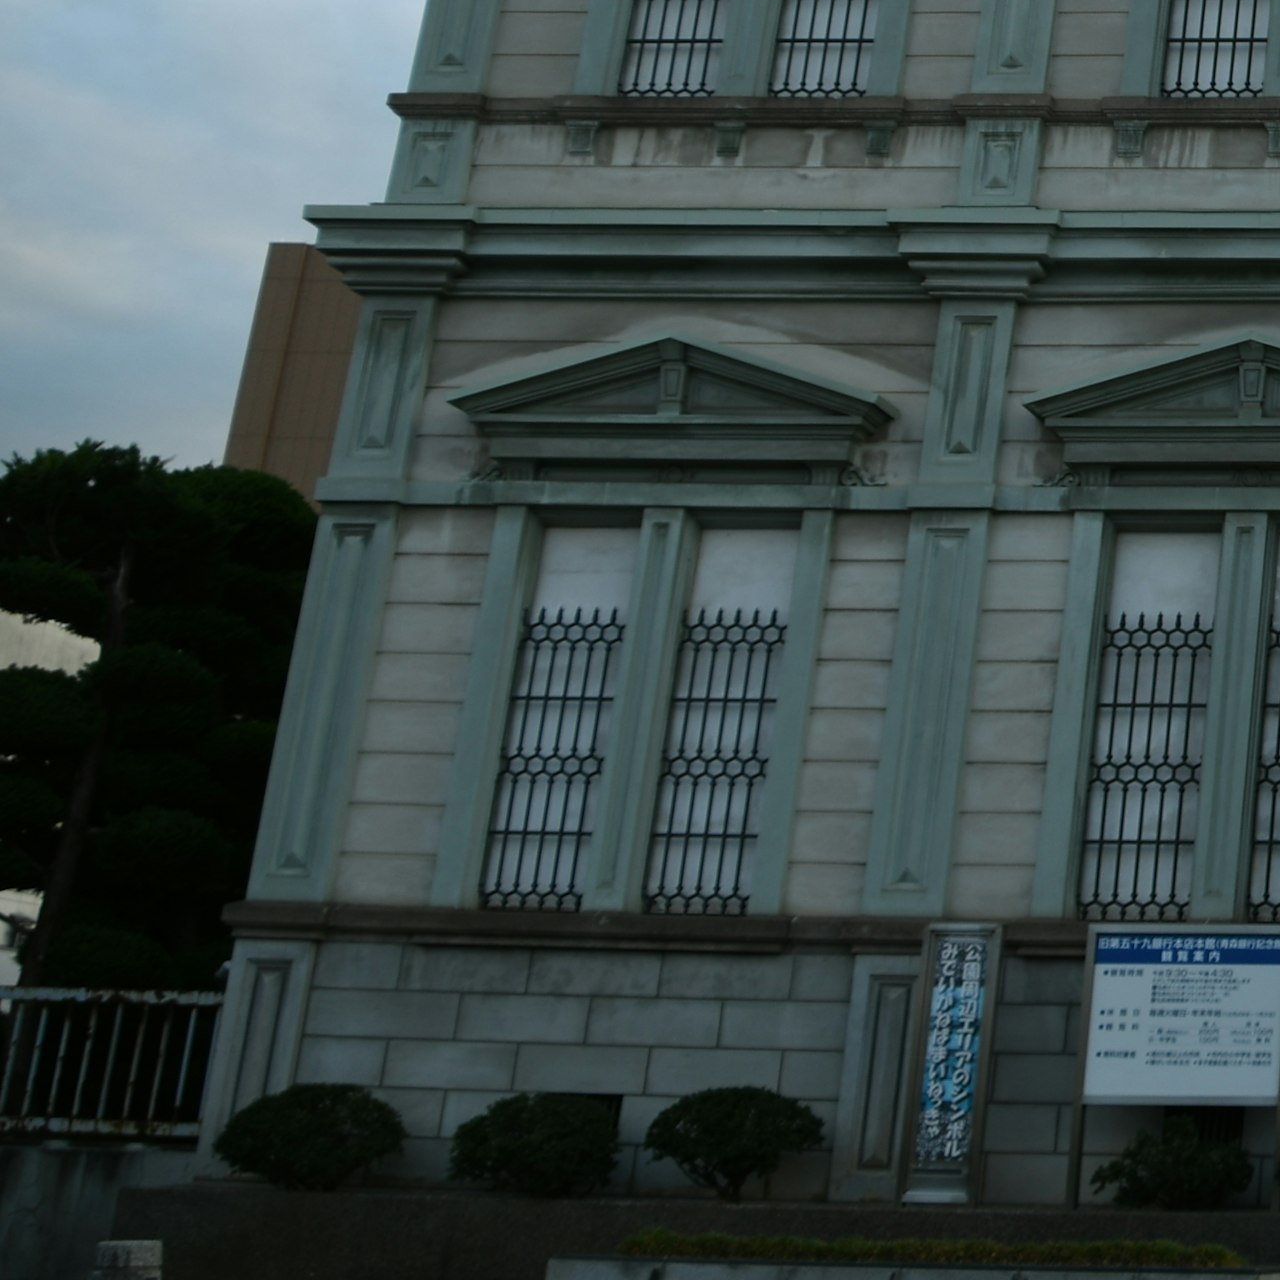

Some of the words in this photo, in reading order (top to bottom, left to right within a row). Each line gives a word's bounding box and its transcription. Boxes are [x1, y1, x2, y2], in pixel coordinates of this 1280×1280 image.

[944, 943, 984, 1158] 公園周辺エリアのシンボル
